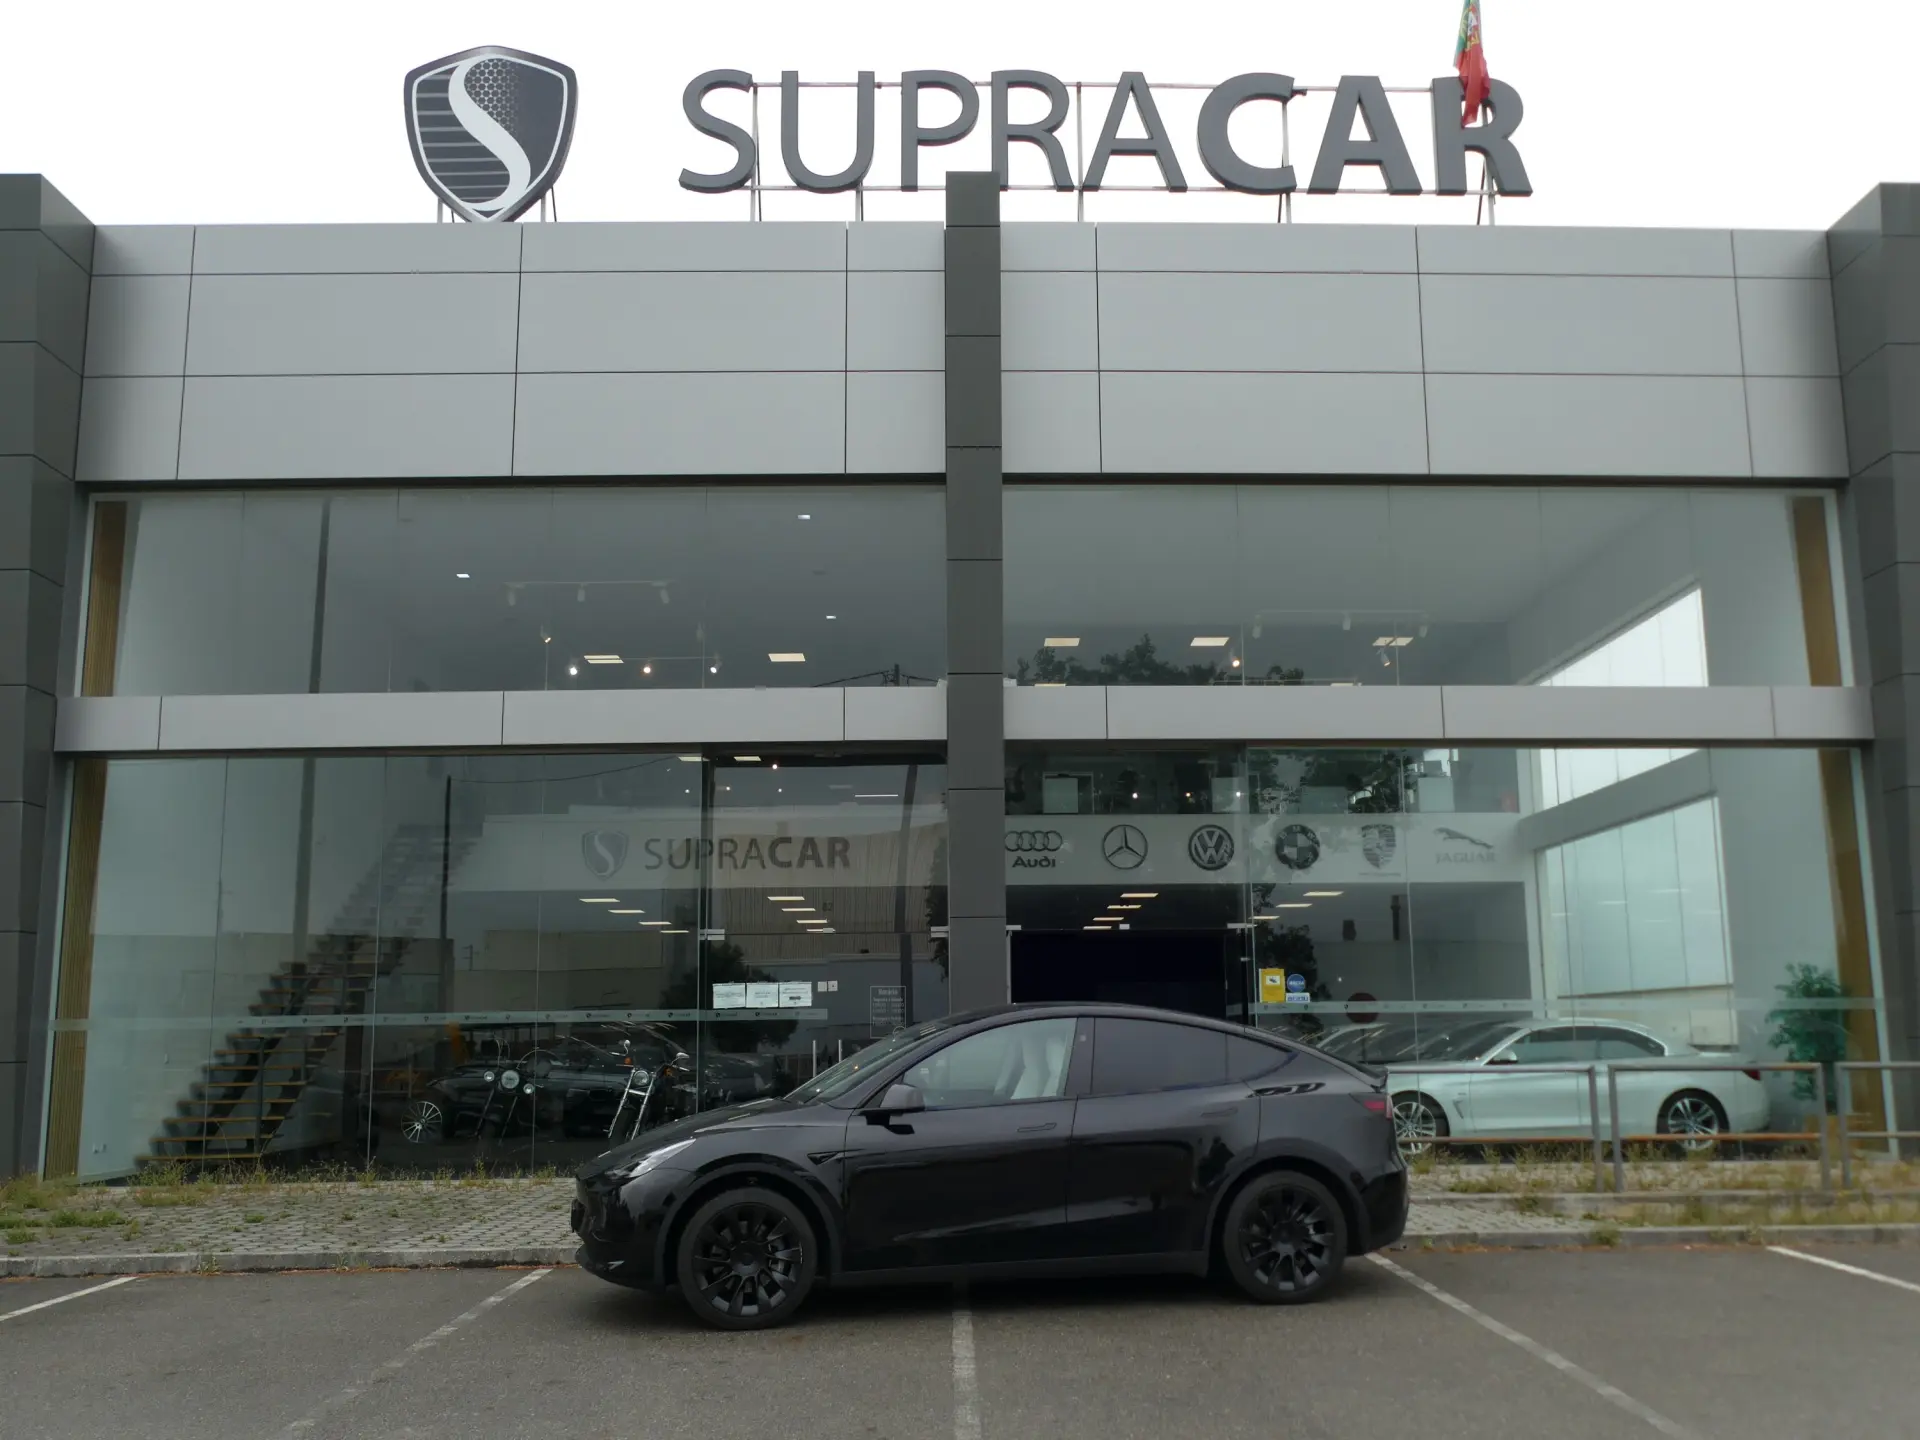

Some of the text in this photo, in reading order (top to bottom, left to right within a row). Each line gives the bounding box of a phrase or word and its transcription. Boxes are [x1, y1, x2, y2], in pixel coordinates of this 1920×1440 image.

[679, 69, 1533, 196] SUPRACAR
[643, 836, 851, 870] SUPRACAR
[1012, 855, 1056, 868] Audi
[1435, 852, 1497, 864] JAGUAR
